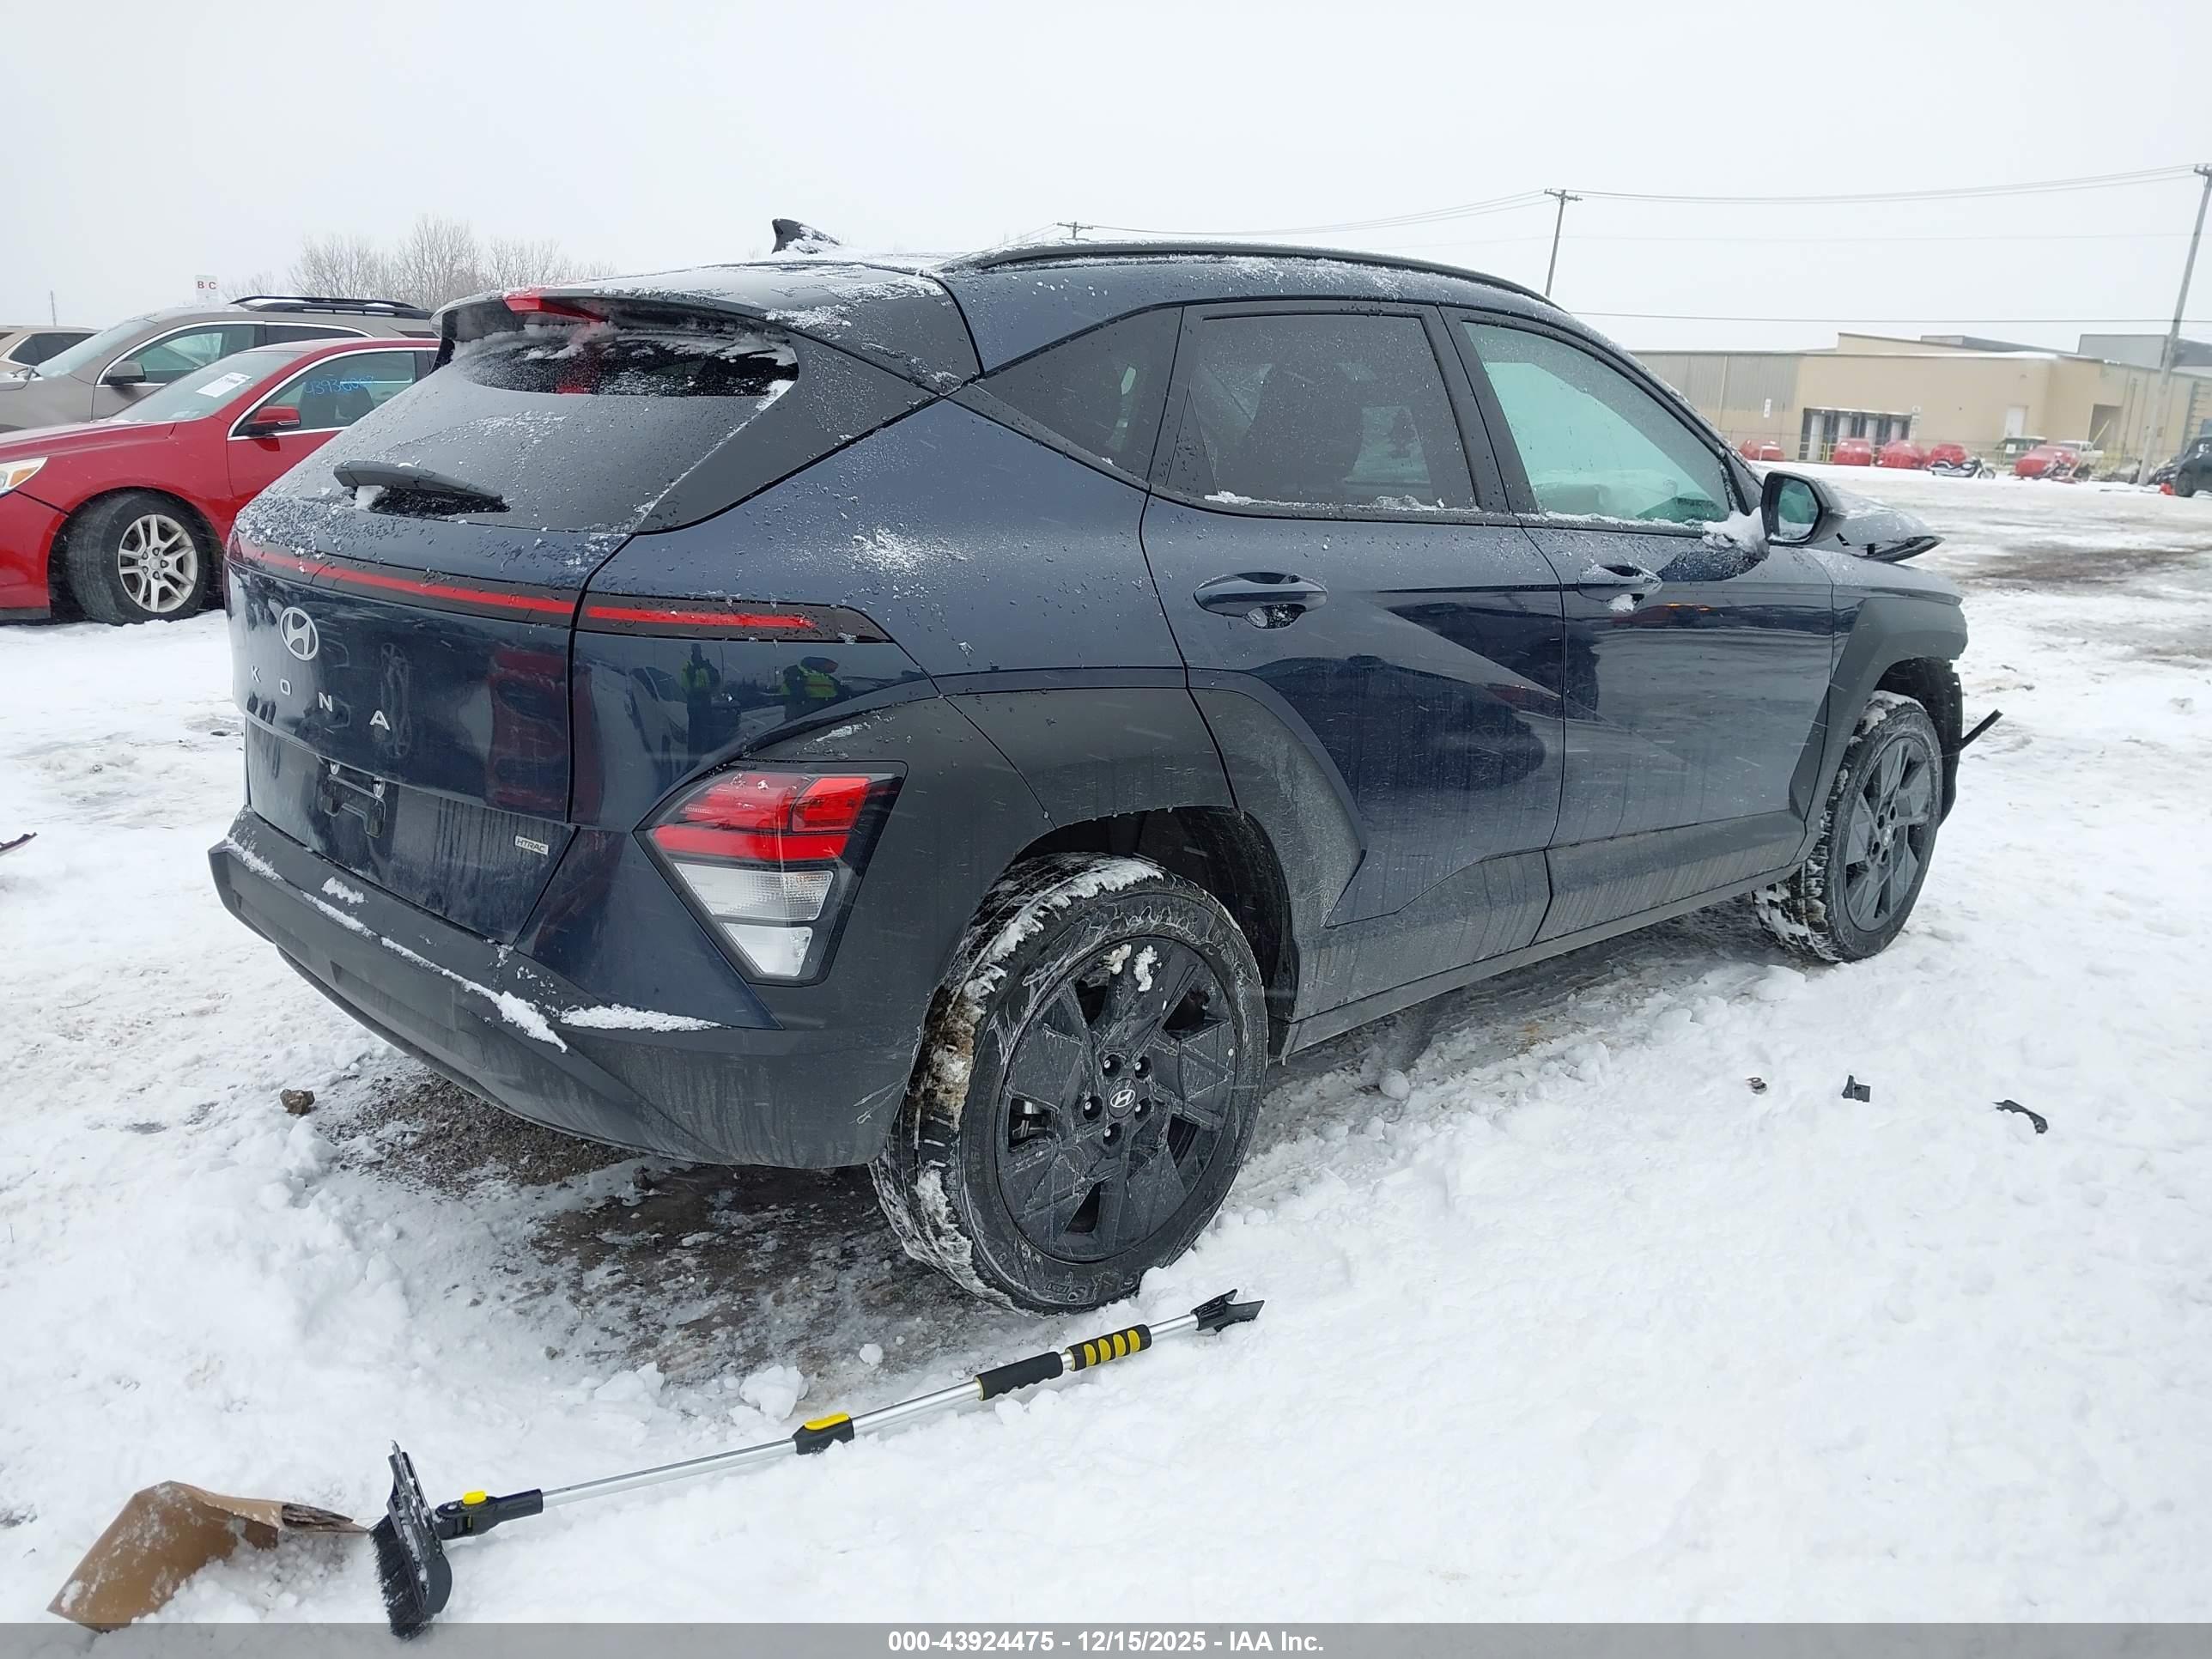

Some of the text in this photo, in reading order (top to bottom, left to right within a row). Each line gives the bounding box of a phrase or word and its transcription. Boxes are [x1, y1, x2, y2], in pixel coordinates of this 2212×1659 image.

[209, 281, 216, 289] C
[251, 665, 391, 731] KONA
[517, 838, 545, 853] HTRAC
